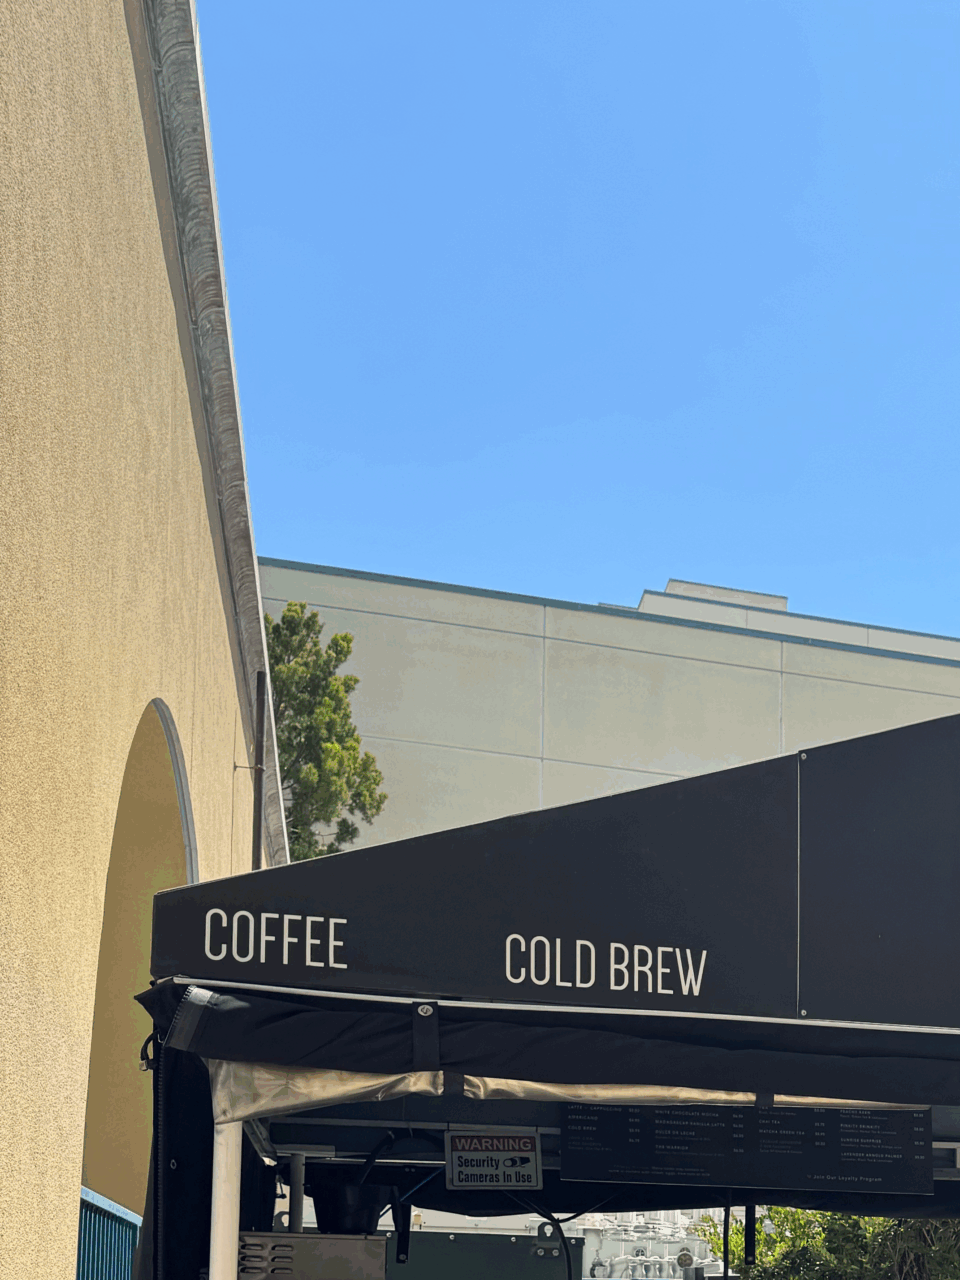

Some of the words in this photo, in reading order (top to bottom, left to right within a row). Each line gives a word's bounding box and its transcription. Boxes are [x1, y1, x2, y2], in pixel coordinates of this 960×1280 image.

[204, 908, 348, 969] COFFEE
[505, 933, 597, 989] COLD
[609, 942, 708, 997] BREW
[456, 1138, 531, 1150] WARNING
[458, 1155, 500, 1170] Security
[458, 1171, 500, 1183] Cameras
[503, 1171, 512, 1183] In
[515, 1171, 532, 1183] Use
